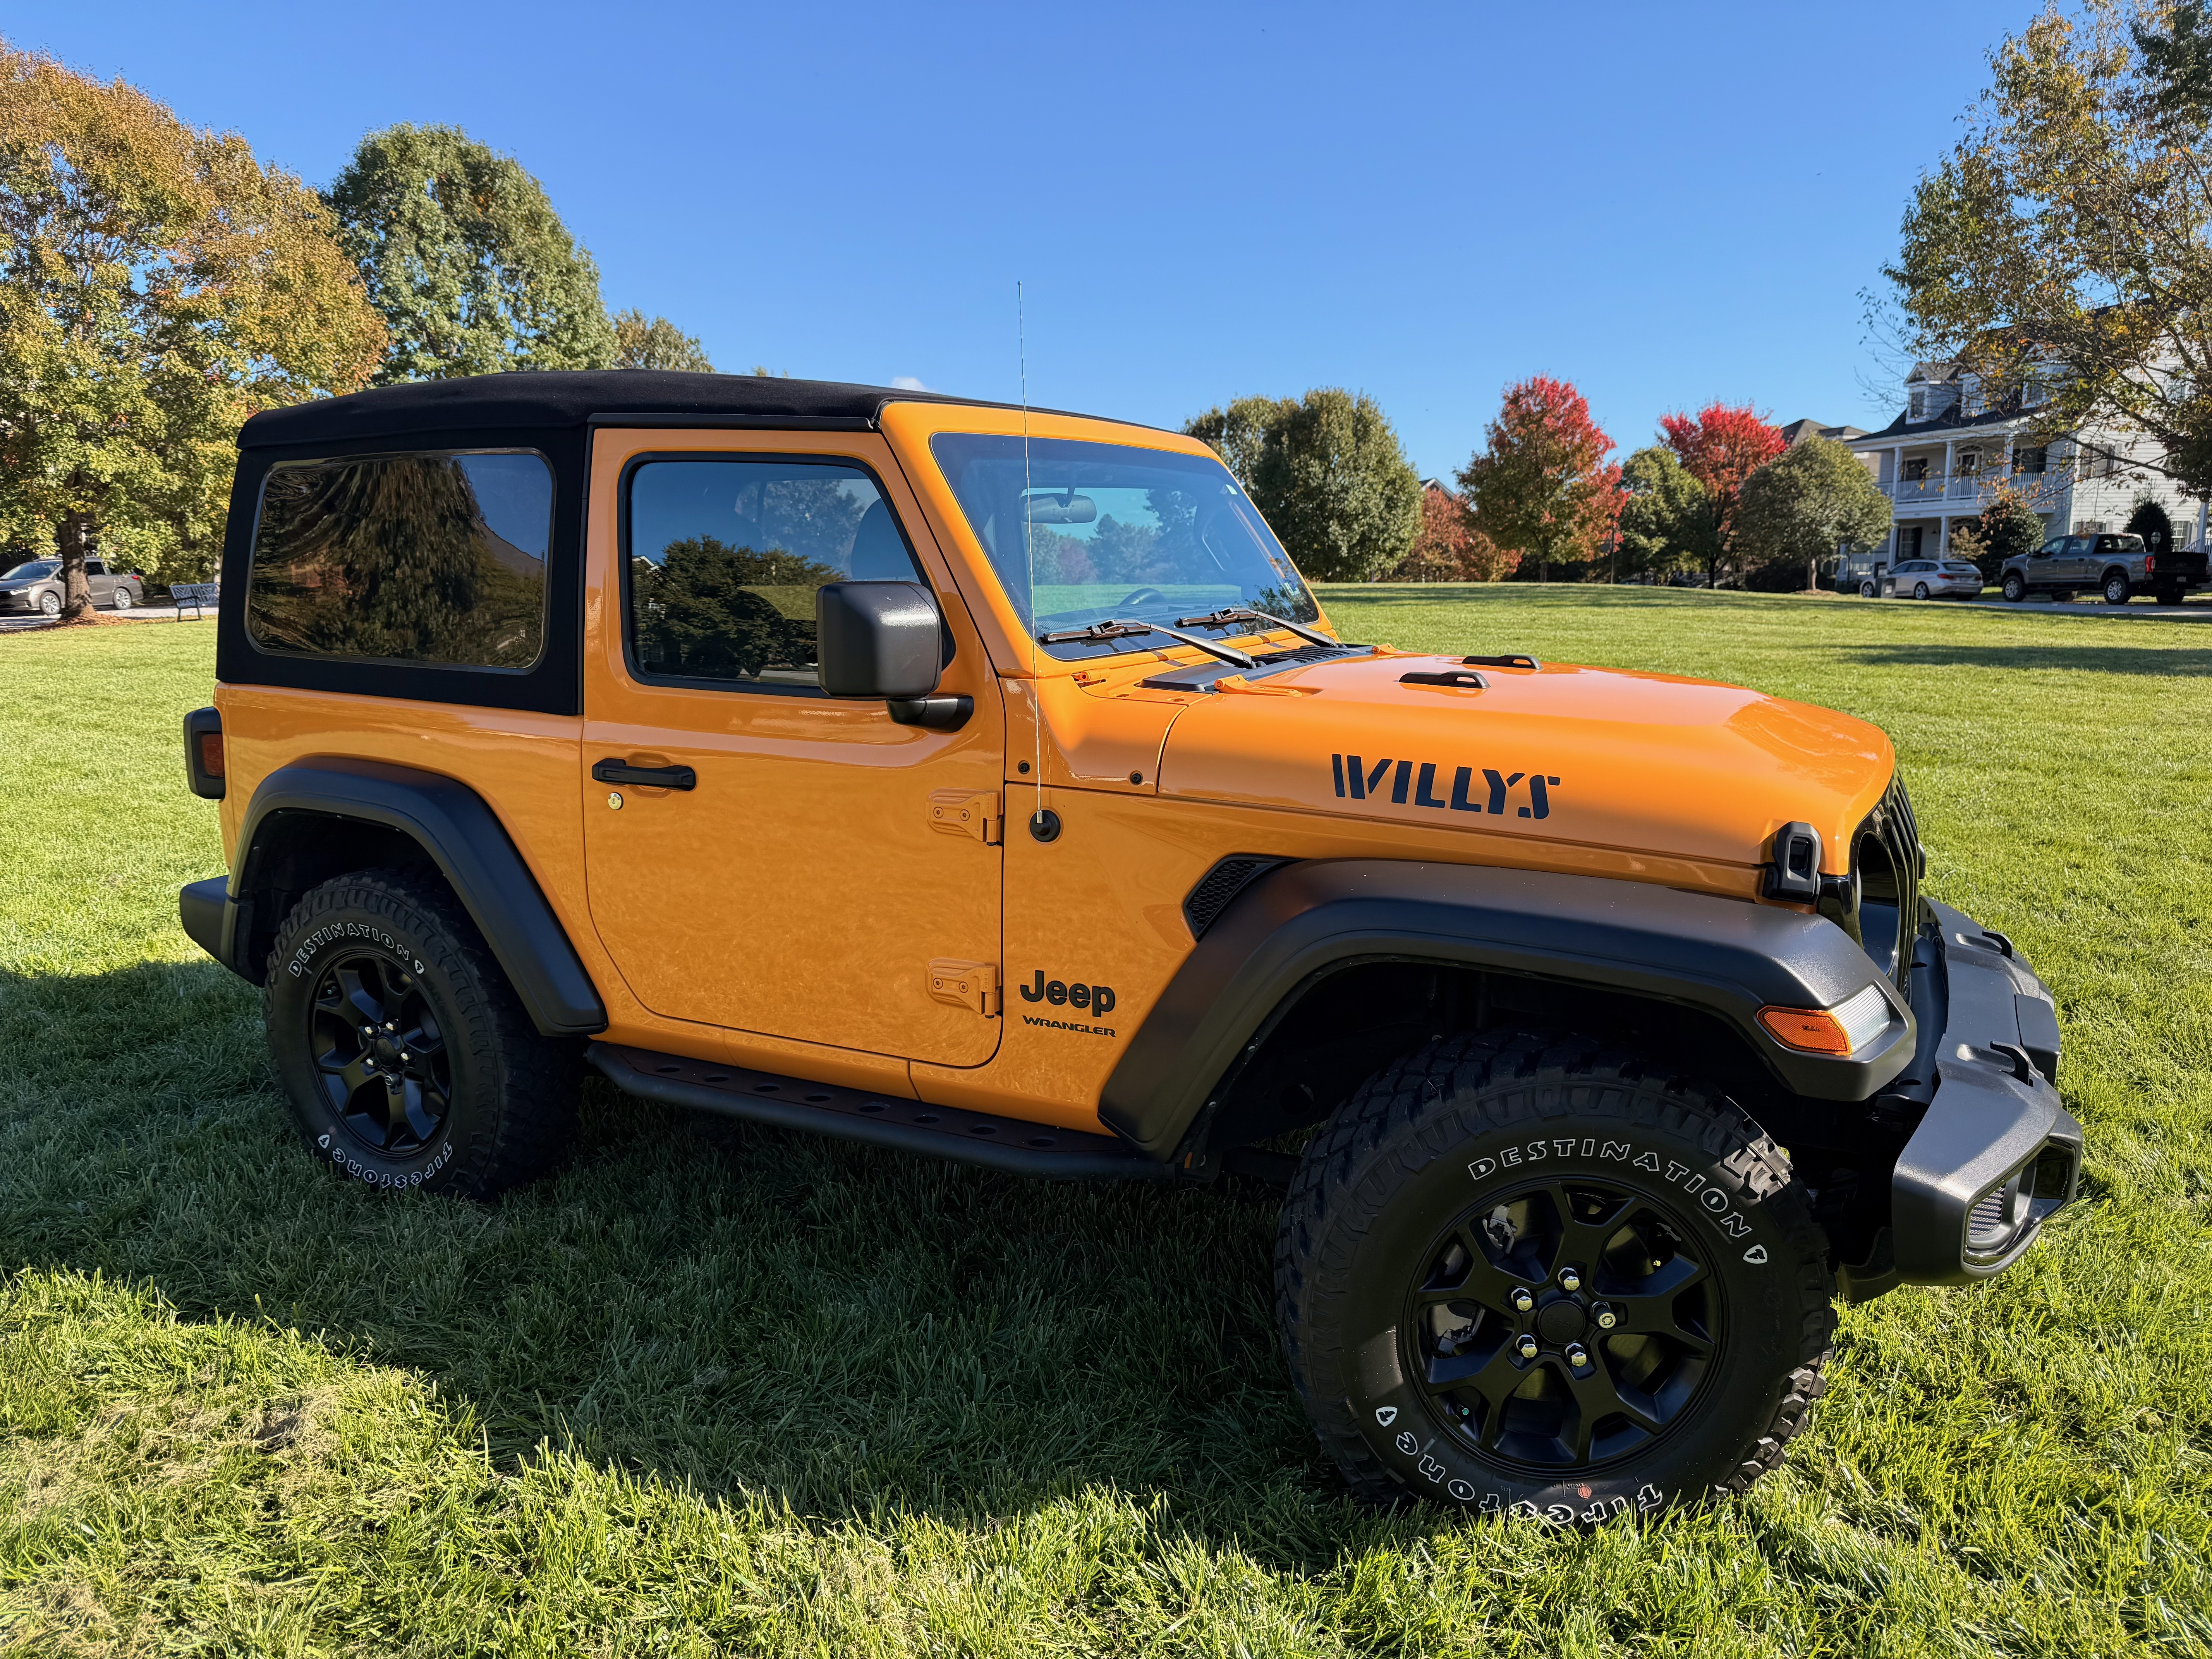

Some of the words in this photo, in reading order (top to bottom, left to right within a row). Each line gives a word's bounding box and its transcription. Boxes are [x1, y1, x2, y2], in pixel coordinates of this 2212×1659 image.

[1331, 753, 1561, 819] WILLYS
[288, 922, 409, 977] DESTINATION
[1020, 970, 1116, 1018] Jeep
[1022, 1015, 1116, 1037] WRANGLER
[333, 1142, 452, 1188] Firestone
[1468, 1139, 1753, 1238] DESTINATION
[1396, 1431, 1663, 1525] Firestone
